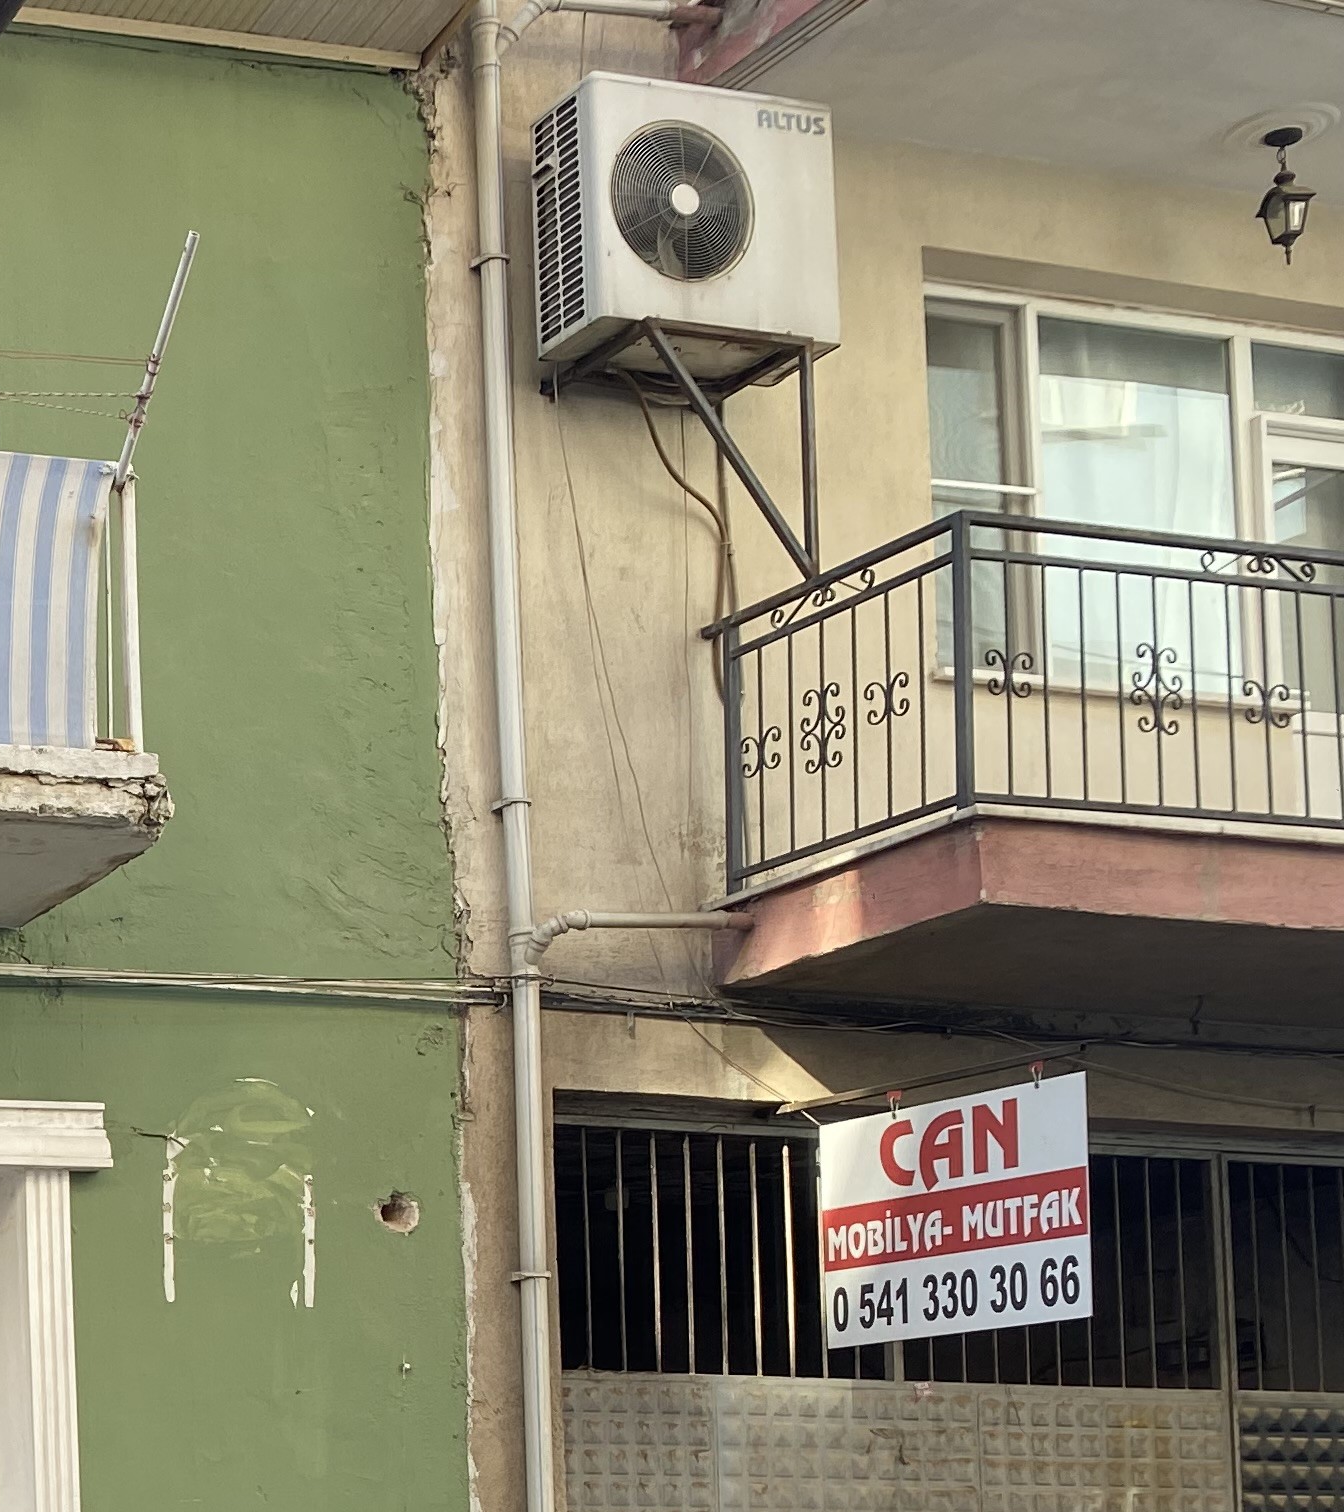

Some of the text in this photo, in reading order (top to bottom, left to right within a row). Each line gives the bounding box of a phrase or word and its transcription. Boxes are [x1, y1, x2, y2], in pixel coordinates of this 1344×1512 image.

[757, 109, 826, 135] ALTUS
[880, 1097, 1019, 1191] CAN
[962, 1187, 1083, 1242] MUTFAK
[833, 1254, 1080, 1332] 0 541 330 30 66
